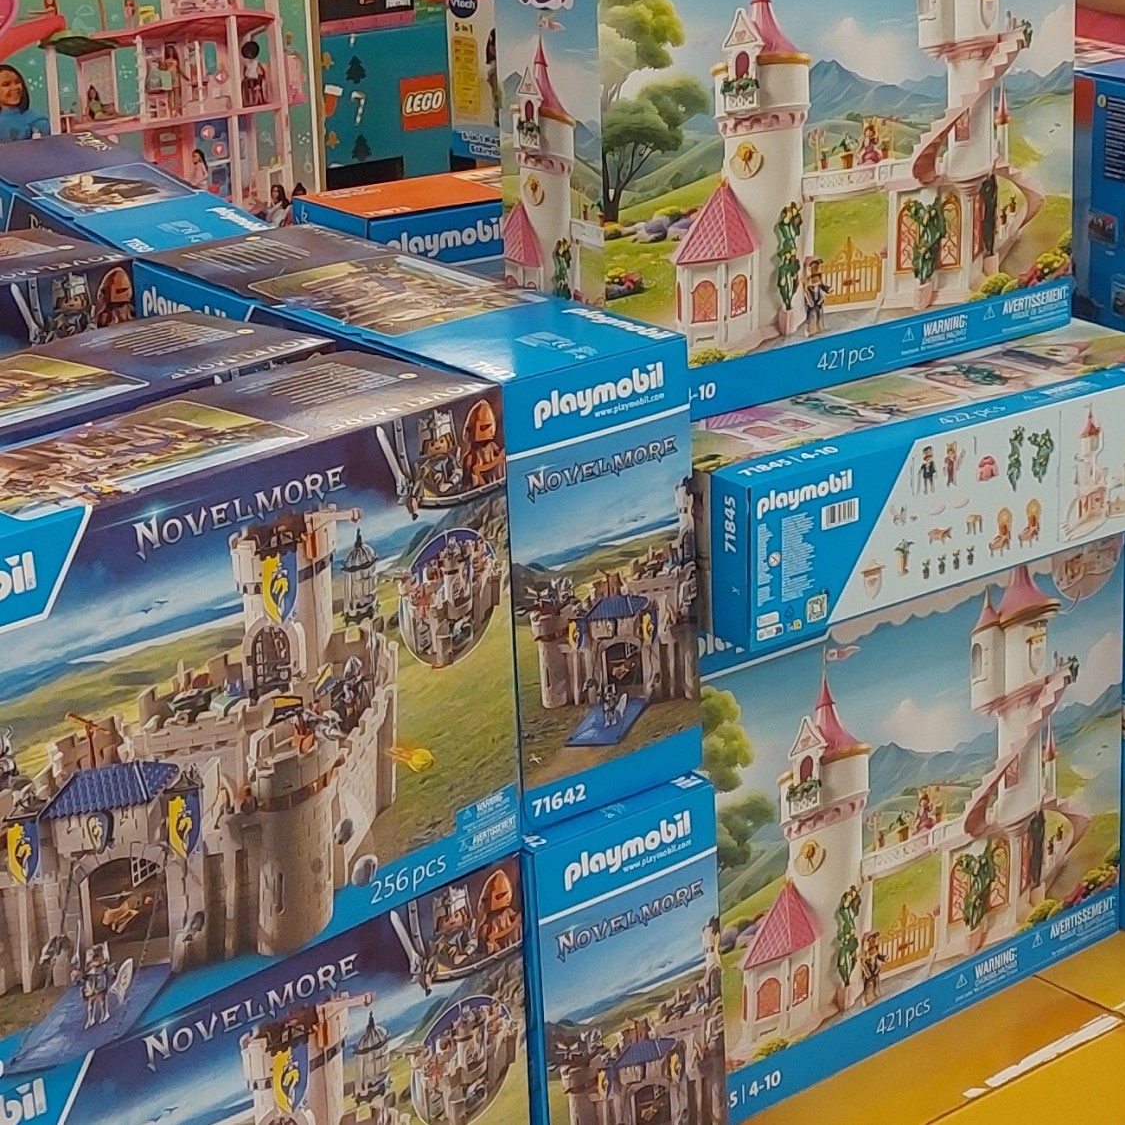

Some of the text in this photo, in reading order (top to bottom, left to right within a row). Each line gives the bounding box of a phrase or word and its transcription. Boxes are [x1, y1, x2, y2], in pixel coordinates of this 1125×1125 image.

[404, 90, 444, 115] LEGO
[1002, 286, 1070, 316] AVERTISSEMENT:
[561, 308, 677, 340] playmobil
[923, 314, 968, 337] WARNING:
[817, 343, 875, 373] 421 pcs
[534, 361, 664, 429] playmobil
[594, 392, 665, 418] www.playmobil.com
[526, 435, 679, 504] NOVELMORE
[737, 446, 839, 477] 71845 4-10
[757, 469, 853, 520] playmobil
[132, 465, 347, 562] NOVELMORE
[724, 495, 737, 554] 71845
[532, 784, 587, 818] 71642
[564, 810, 692, 891] playmobil
[622, 838, 692, 873] www.playmobil.com
[370, 854, 447, 906] 256 pcs
[556, 878, 704, 963] NOVELMORE
[974, 947, 1018, 980] WARNING:
[142, 954, 362, 1072] NOVELMORE
[876, 996, 931, 1037] 421 pcs
[748, 1070, 781, 1098] 4-10
